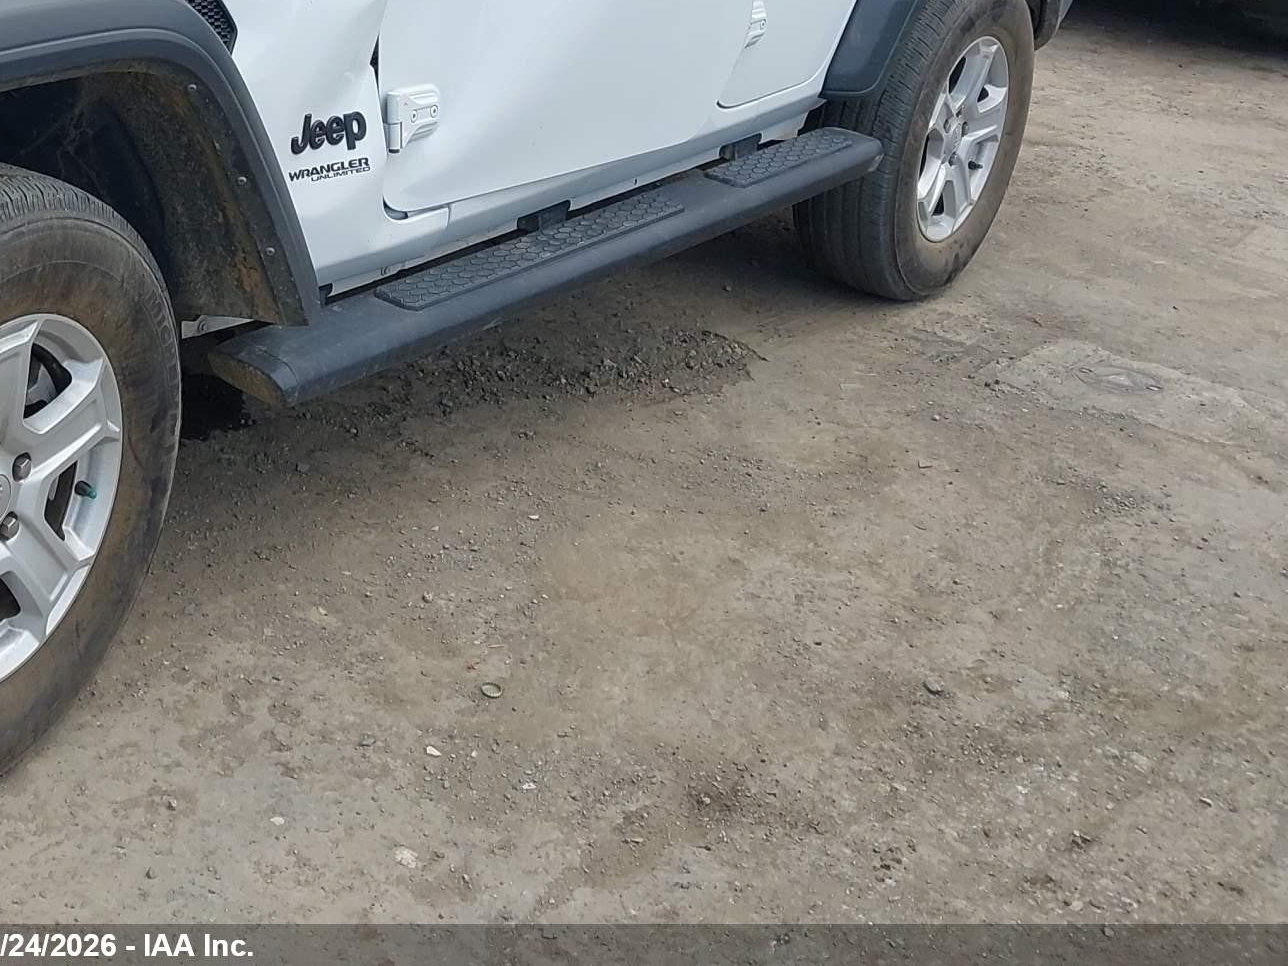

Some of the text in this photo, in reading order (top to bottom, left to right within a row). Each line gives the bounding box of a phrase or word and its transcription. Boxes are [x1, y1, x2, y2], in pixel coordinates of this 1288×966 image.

[291, 111, 367, 155] Jeep
[288, 157, 369, 182] WRANGLER
[311, 167, 370, 181] UNLIMITED
